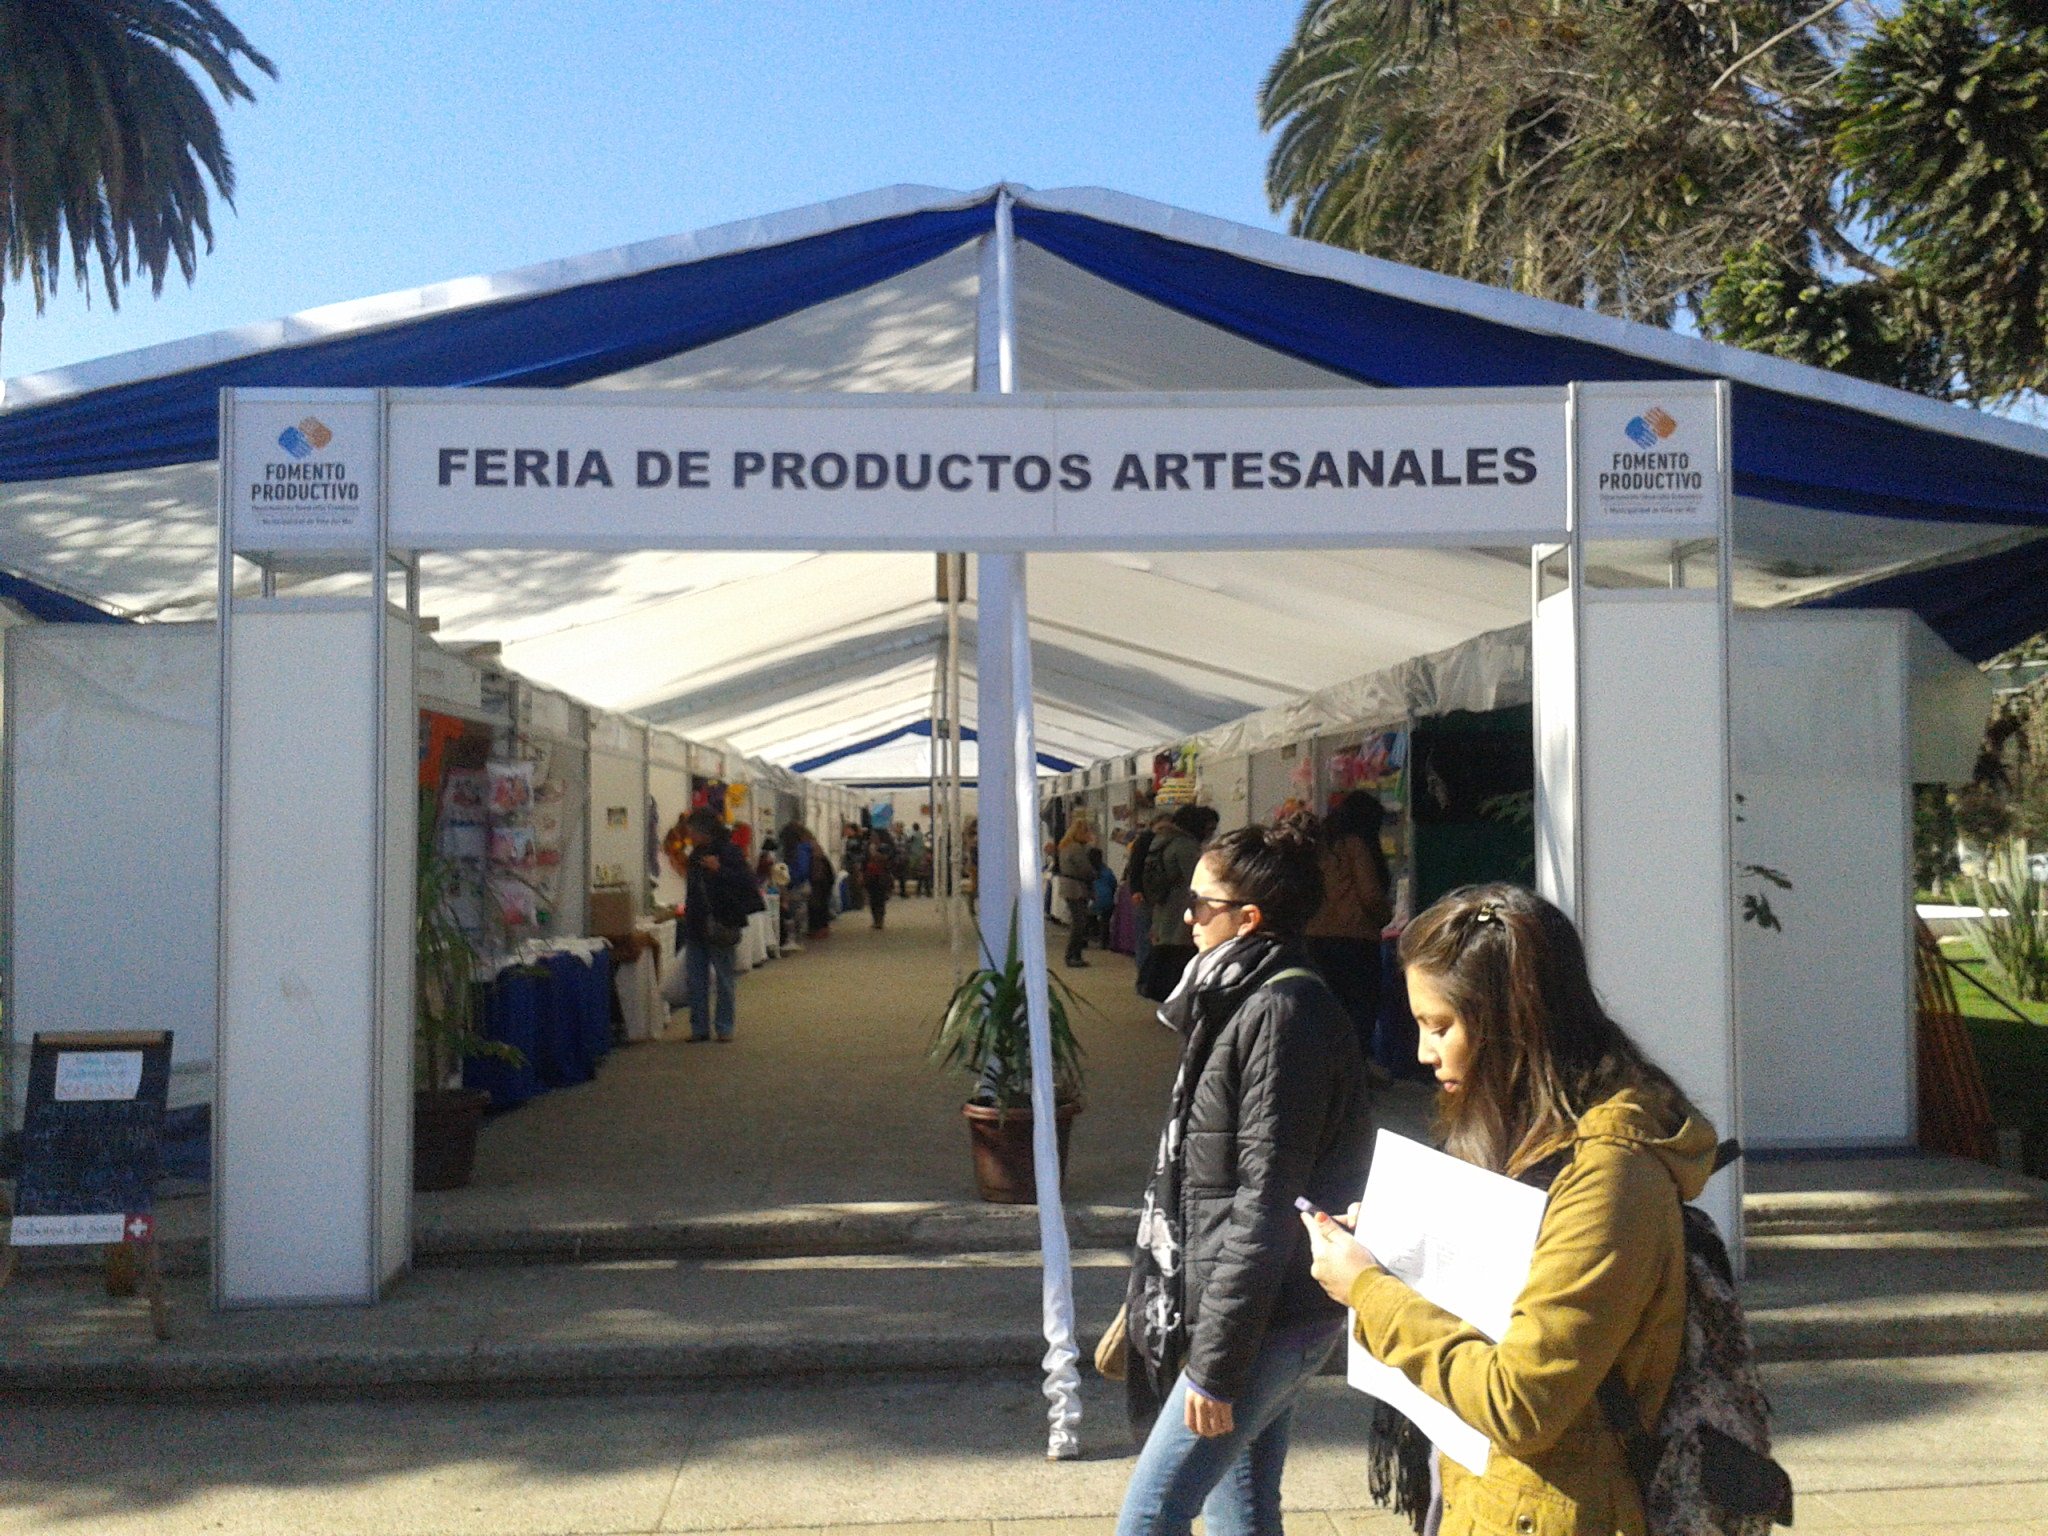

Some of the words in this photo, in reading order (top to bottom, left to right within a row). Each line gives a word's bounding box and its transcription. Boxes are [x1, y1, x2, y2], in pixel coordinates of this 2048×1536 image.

[439, 448, 613, 488] FERIA
[637, 450, 710, 488] DE
[734, 451, 1092, 493] PRODUCTOS
[1113, 446, 1538, 491] ARTESANALES
[1612, 453, 1689, 470] FOMENTO
[266, 463, 345, 481] FOMENTO
[1599, 472, 1702, 490] PRODUCTIVO
[251, 483, 358, 501] PRODUCTIVO
